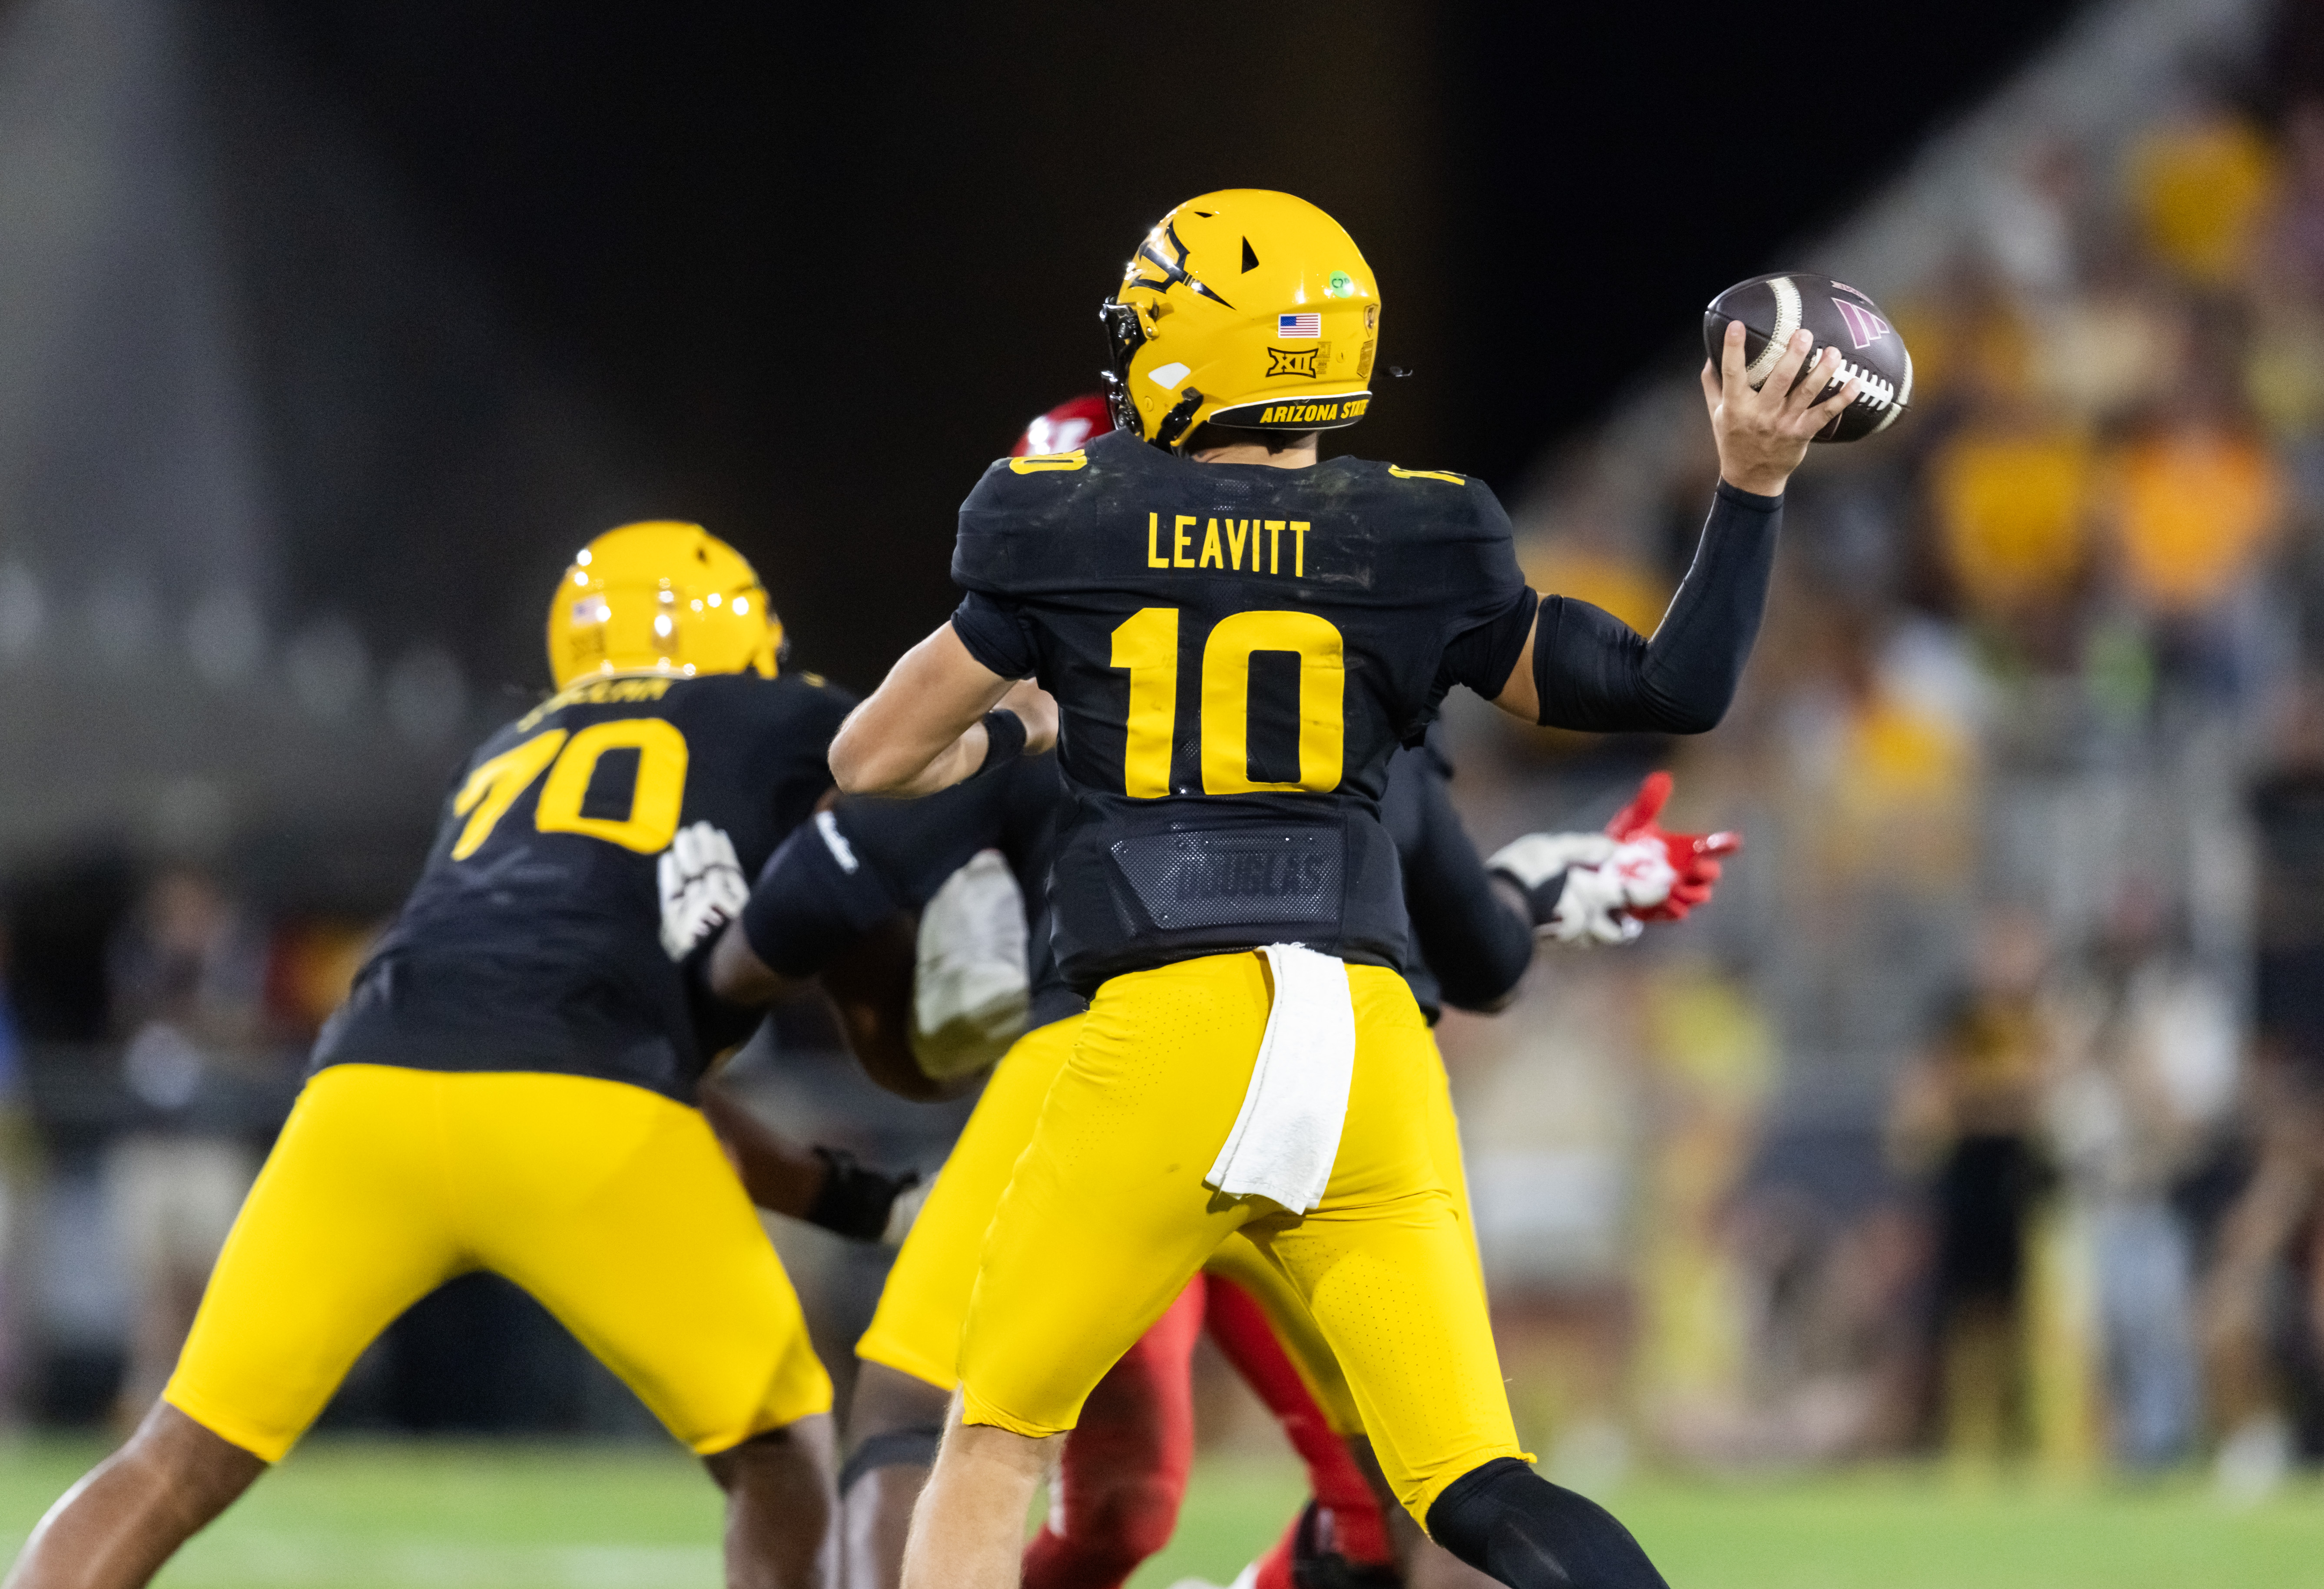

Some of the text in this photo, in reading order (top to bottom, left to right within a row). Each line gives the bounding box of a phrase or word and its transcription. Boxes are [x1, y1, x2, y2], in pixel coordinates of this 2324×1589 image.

[1266, 347, 1319, 378] XII
[1260, 399, 1369, 423] ARIZONA STATE
[1148, 512, 1310, 577] LEAVITT
[1110, 608, 1344, 798] 10
[452, 718, 689, 861] 70
